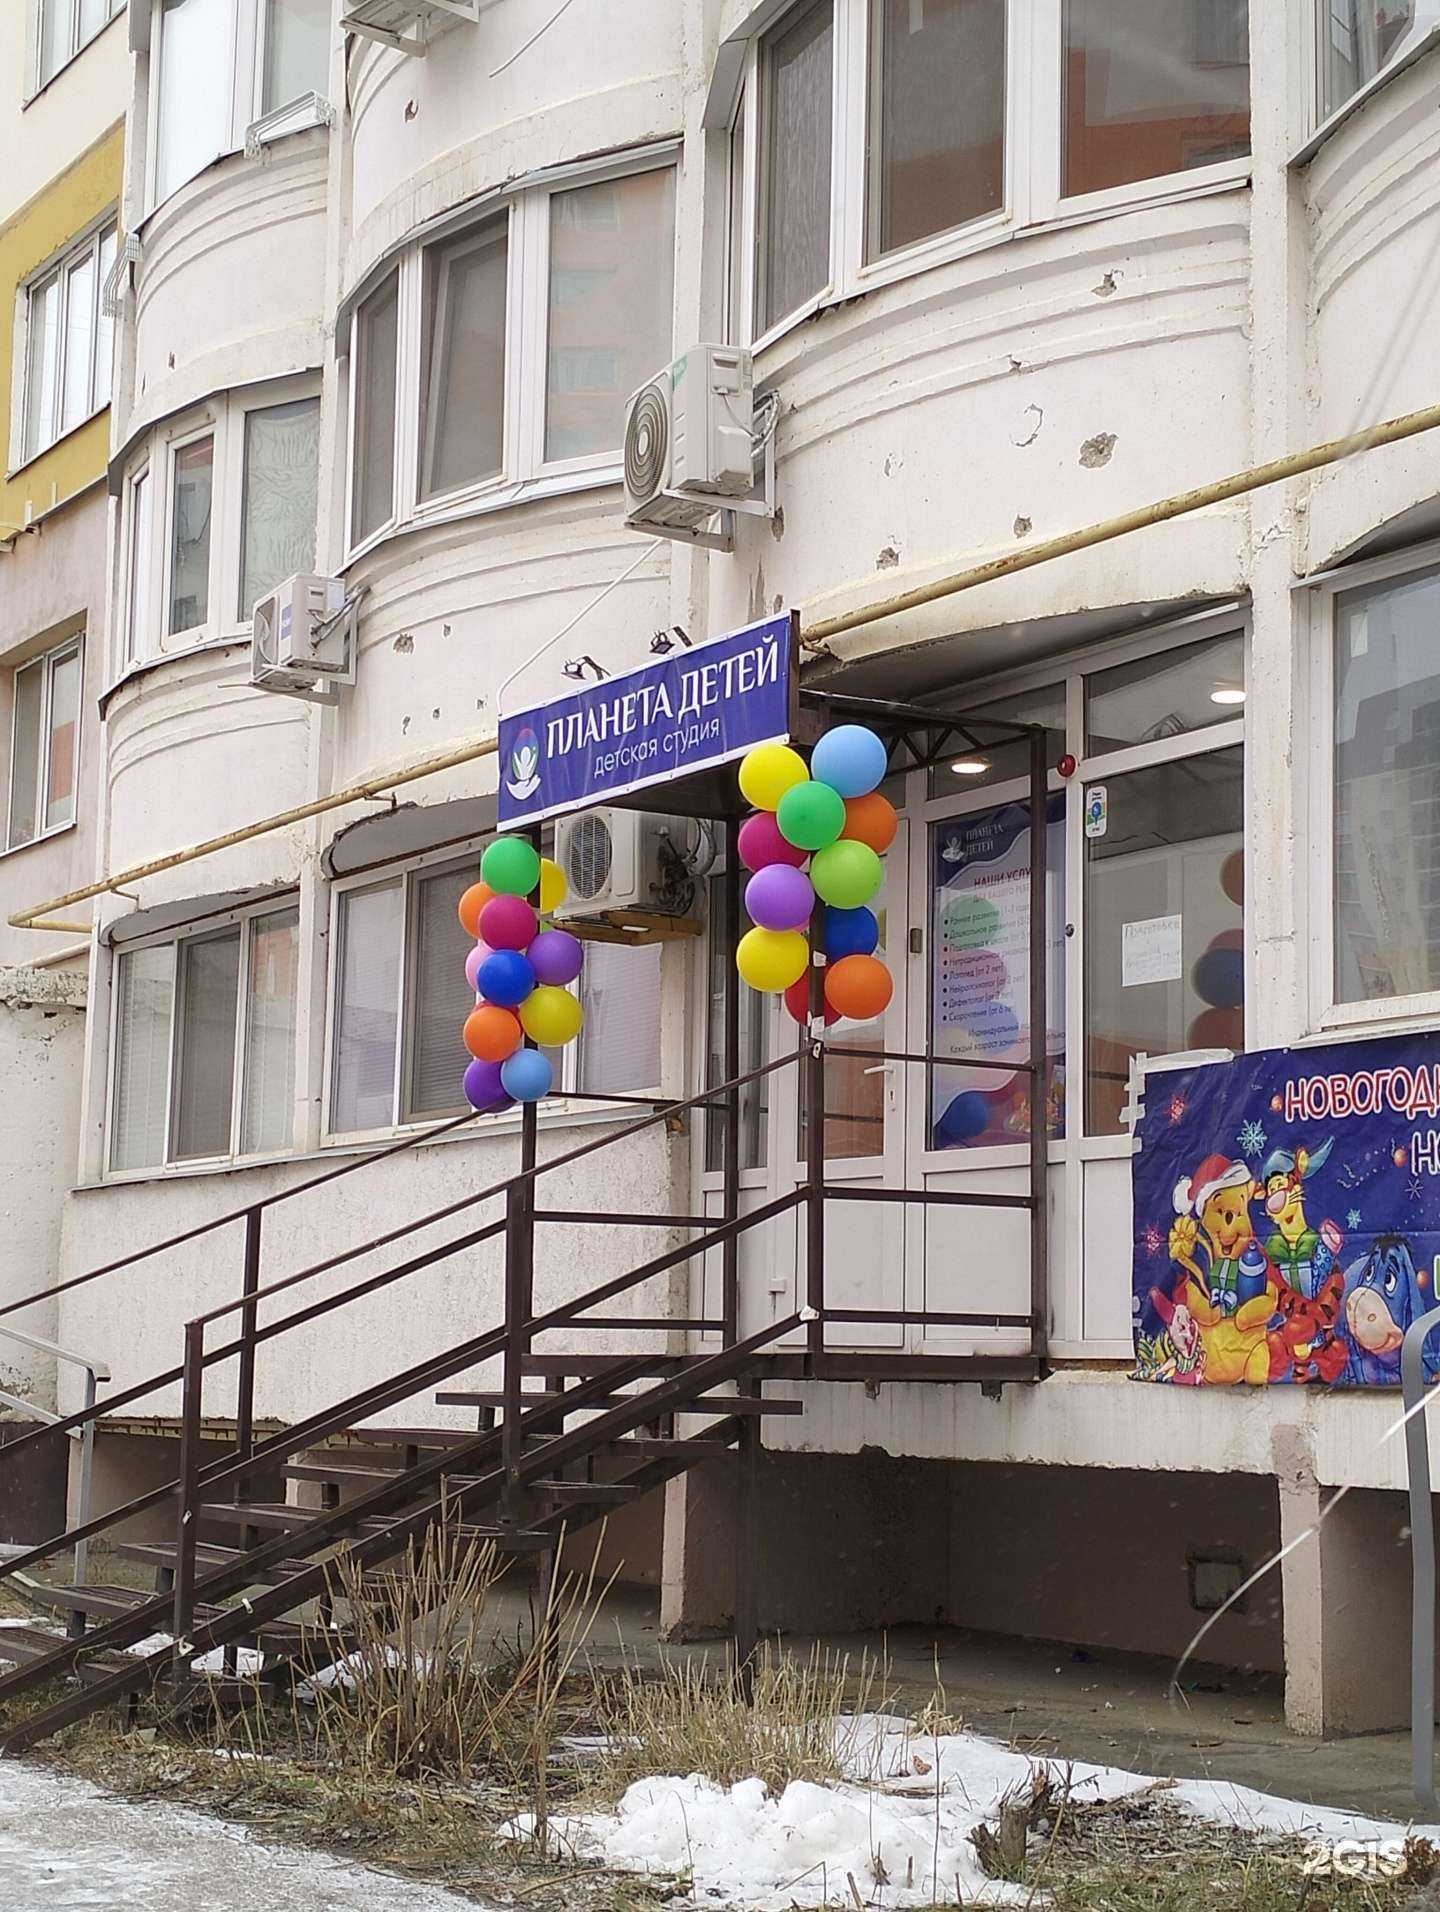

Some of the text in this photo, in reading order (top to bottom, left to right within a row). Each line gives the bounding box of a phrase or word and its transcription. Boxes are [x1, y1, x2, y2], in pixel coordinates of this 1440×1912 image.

[546, 634, 778, 758] ПЛАНЕТА ДЕТЕЙ
[594, 718, 719, 778] детская студия
[1284, 1064, 1440, 1122] НОВОГОД
